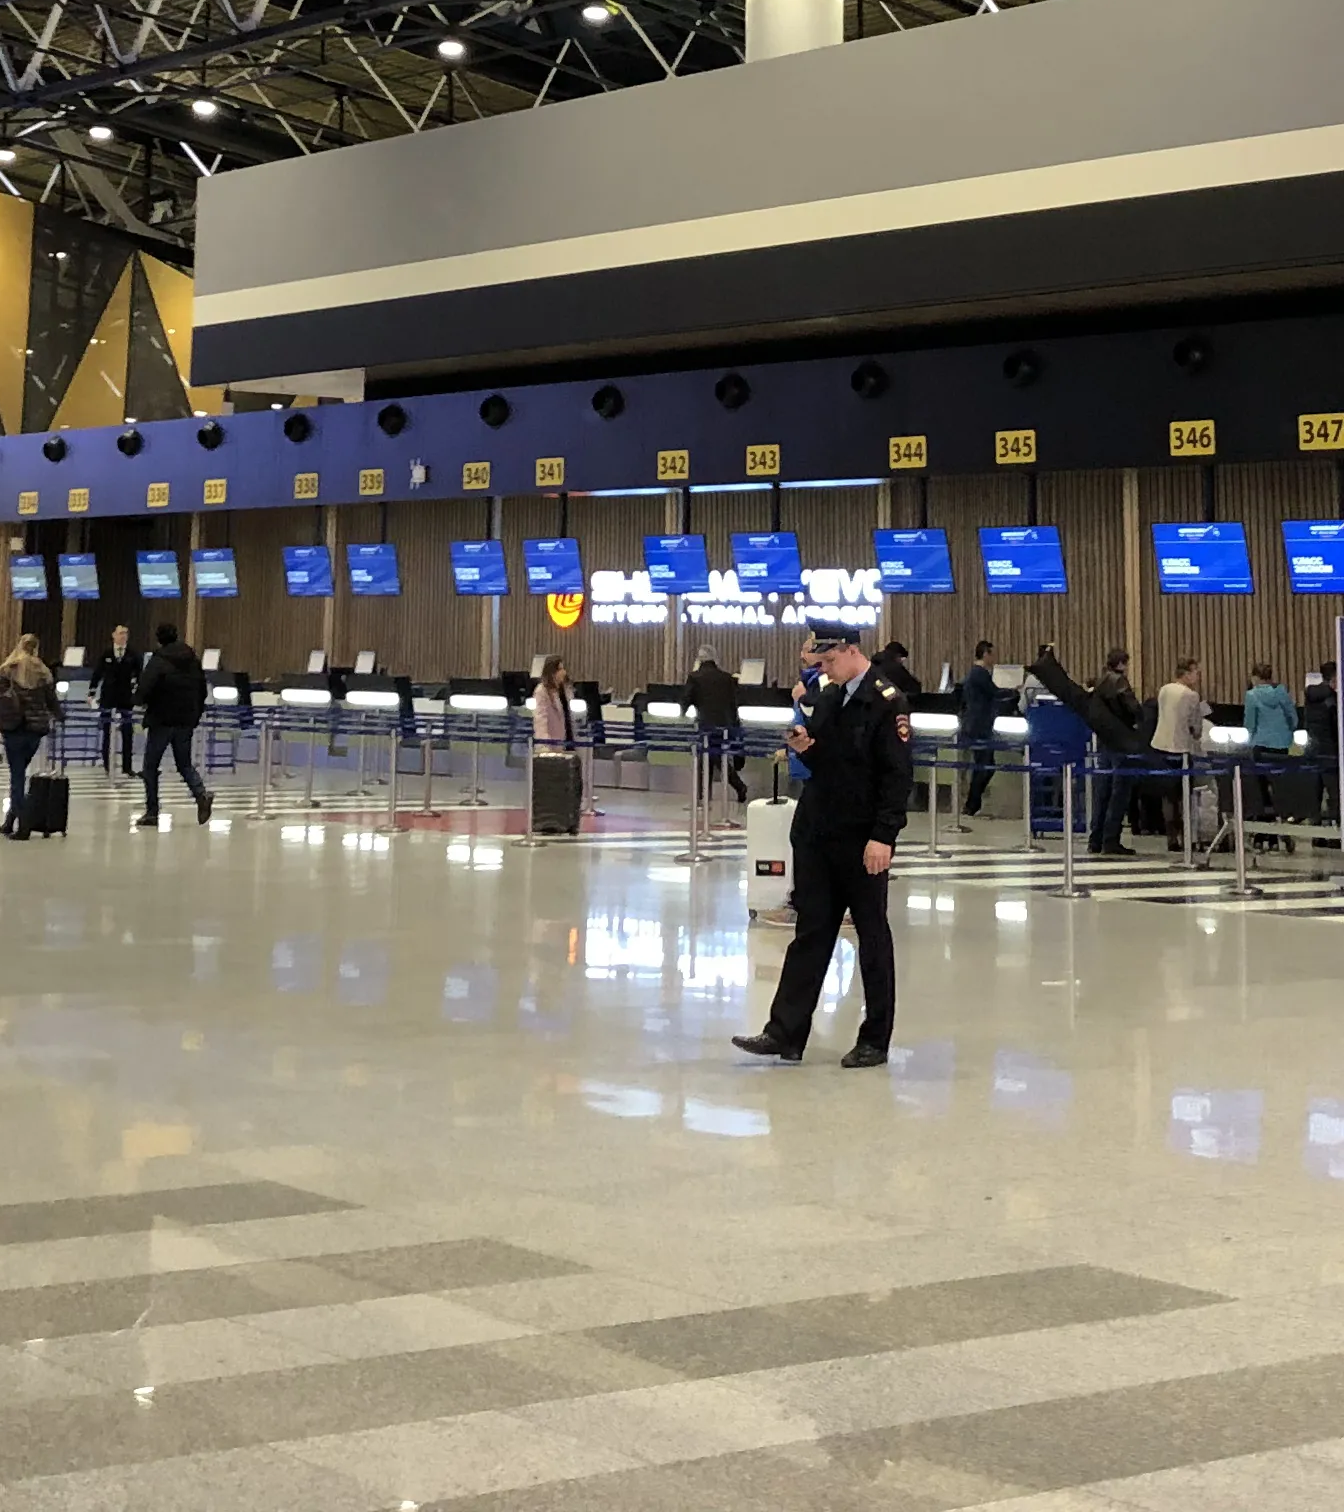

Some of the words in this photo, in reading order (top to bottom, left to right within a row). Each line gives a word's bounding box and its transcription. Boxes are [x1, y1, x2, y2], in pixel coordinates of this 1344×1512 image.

[1173, 426, 1212, 450] 346
[1302, 419, 1344, 444] 347
[892, 441, 924, 463] 344
[999, 436, 1033, 458] 345
[658, 454, 686, 476] 342
[748, 450, 777, 471] 343
[359, 472, 383, 492] 339
[464, 466, 489, 485] 340
[538, 462, 562, 482] 341
